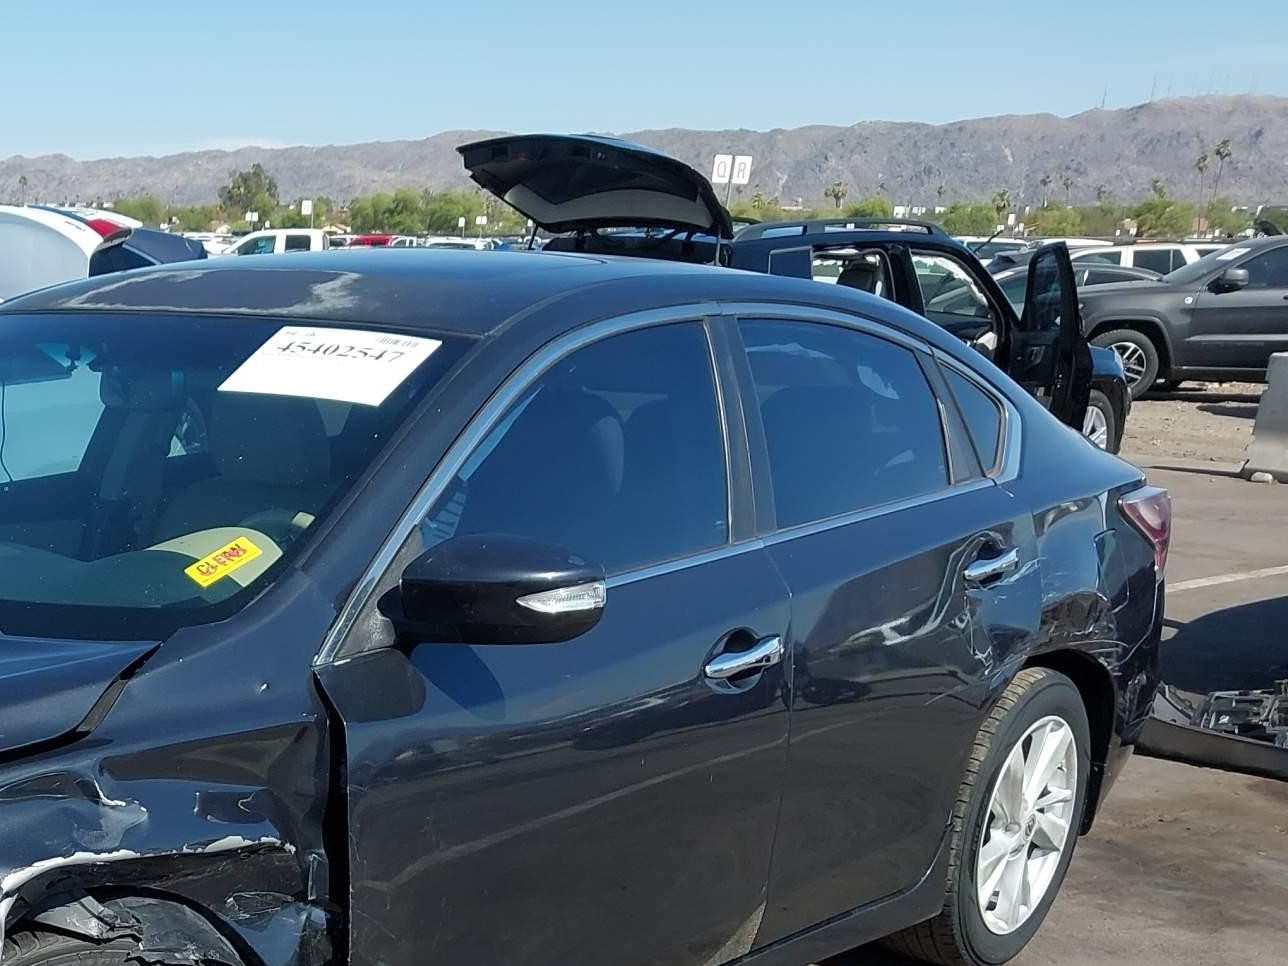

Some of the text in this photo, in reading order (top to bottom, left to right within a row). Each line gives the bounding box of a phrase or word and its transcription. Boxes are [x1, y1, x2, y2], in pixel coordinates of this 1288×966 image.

[717, 161, 727, 178] Q
[737, 162, 746, 179] R
[277, 341, 405, 363] 45402547
